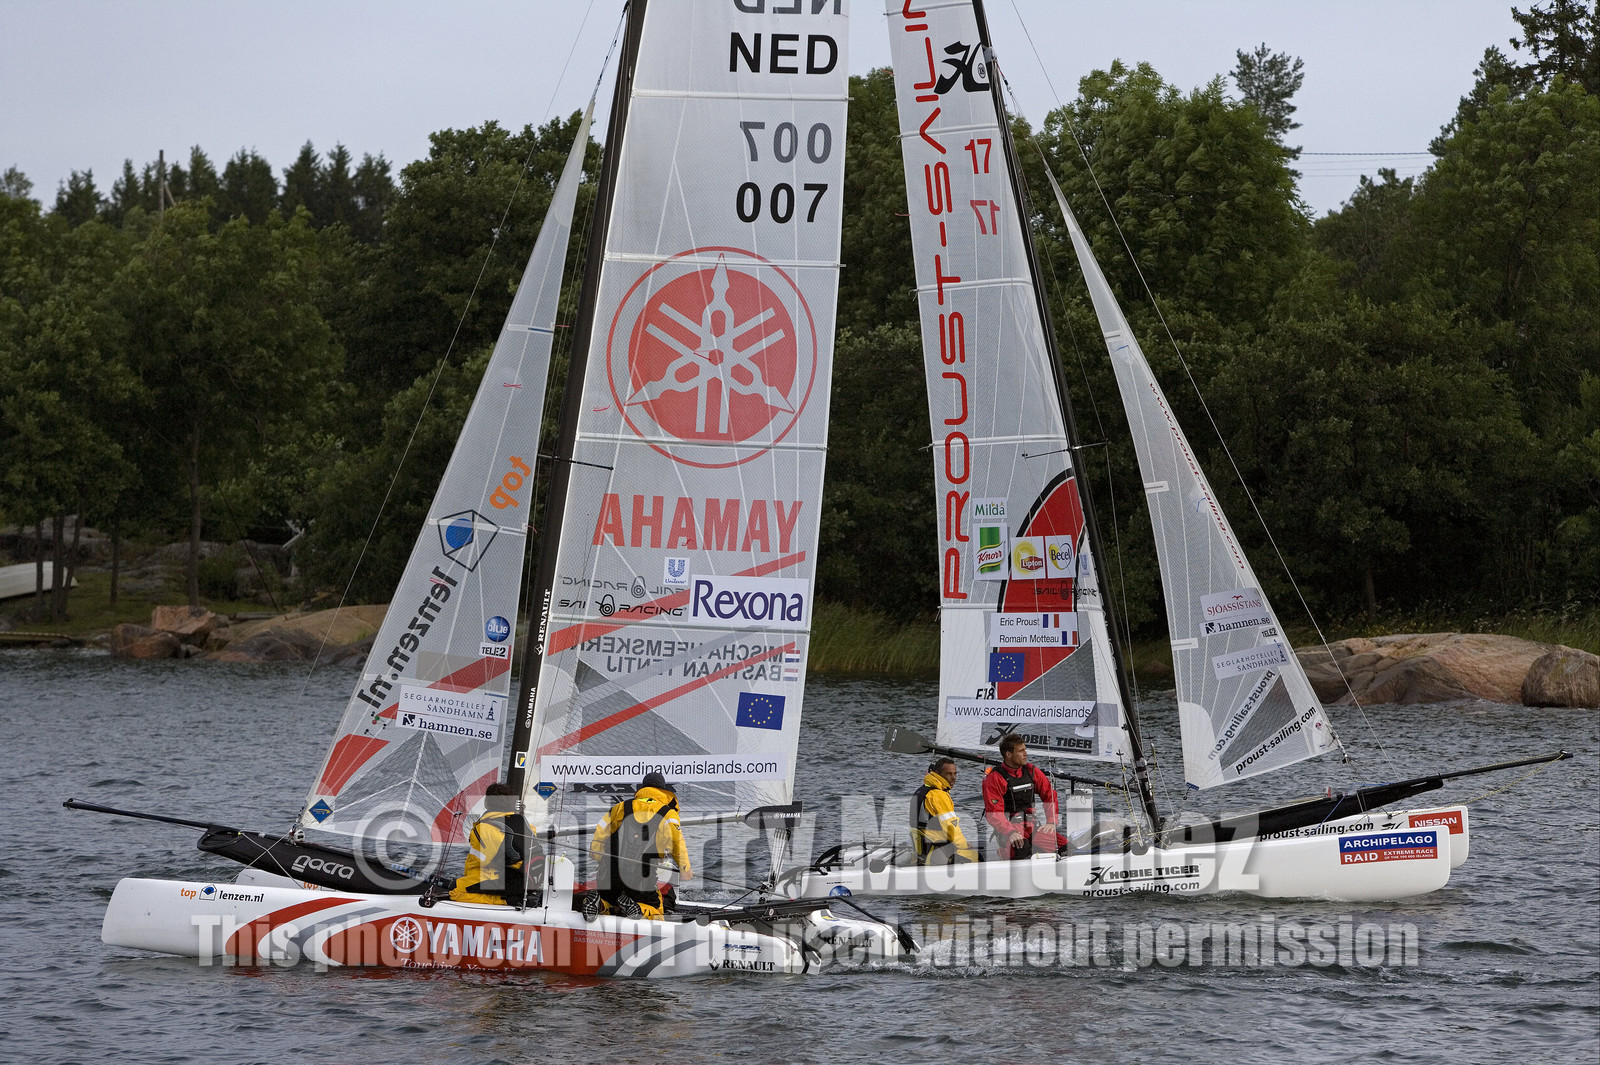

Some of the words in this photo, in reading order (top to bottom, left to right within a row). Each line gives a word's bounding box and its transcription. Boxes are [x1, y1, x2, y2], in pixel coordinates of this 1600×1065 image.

[729, 32, 839, 75] NED
[964, 138, 992, 175] 17
[736, 182, 829, 224] 007
[974, 502, 1005, 516] Milda
[976, 549, 1003, 564] Knorr
[1050, 548, 1072, 561] Becel
[1021, 558, 1043, 568] Lipton
[692, 579, 803, 622] Rexona
[1207, 599, 1262, 617] SJÖASSISTANS
[537, 589, 551, 644] RENAULT
[618, 604, 683, 617] RACING
[1000, 617, 1014, 627] Eric
[1016, 617, 1040, 627] Proust
[1218, 616, 1271, 632] hamnen.se
[1000, 634, 1027, 644] Romain
[1029, 634, 1059, 644] Motteau
[1261, 627, 1278, 638] TELE2
[481, 646, 507, 658] TELE2
[1216, 650, 1278, 669] SEGLARHOTELLET
[1237, 657, 1279, 673] SANDHAMN
[404, 692, 486, 711] SEGLARHOTELLET
[526, 687, 537, 720] YAMAHA
[426, 704, 484, 720] SANDHAMN
[954, 704, 1092, 719] www.scandinavianislands
[417, 717, 493, 740] hamnen.se
[1055, 736, 1093, 749] TIGER
[1235, 705, 1317, 775] proust-sailing.com
[552, 760, 778, 776] www.scandinavianislands.com
[1414, 816, 1458, 828] NISSAN
[1259, 821, 1374, 842] proust-sailing.com
[1344, 834, 1433, 849] ARCHIPELAGO
[1344, 852, 1379, 863] RAID
[291, 854, 355, 880] nacra
[1109, 868, 1153, 880] HOBIE
[1155, 864, 1200, 876] TIGER
[180, 887, 197, 900] top
[219, 889, 264, 903] lenzen.nl
[1083, 882, 1200, 898] proust-sailing.com
[426, 921, 544, 963] YAMAHA
[824, 935, 875, 949] RENAULT
[722, 959, 776, 971] RENAULT
